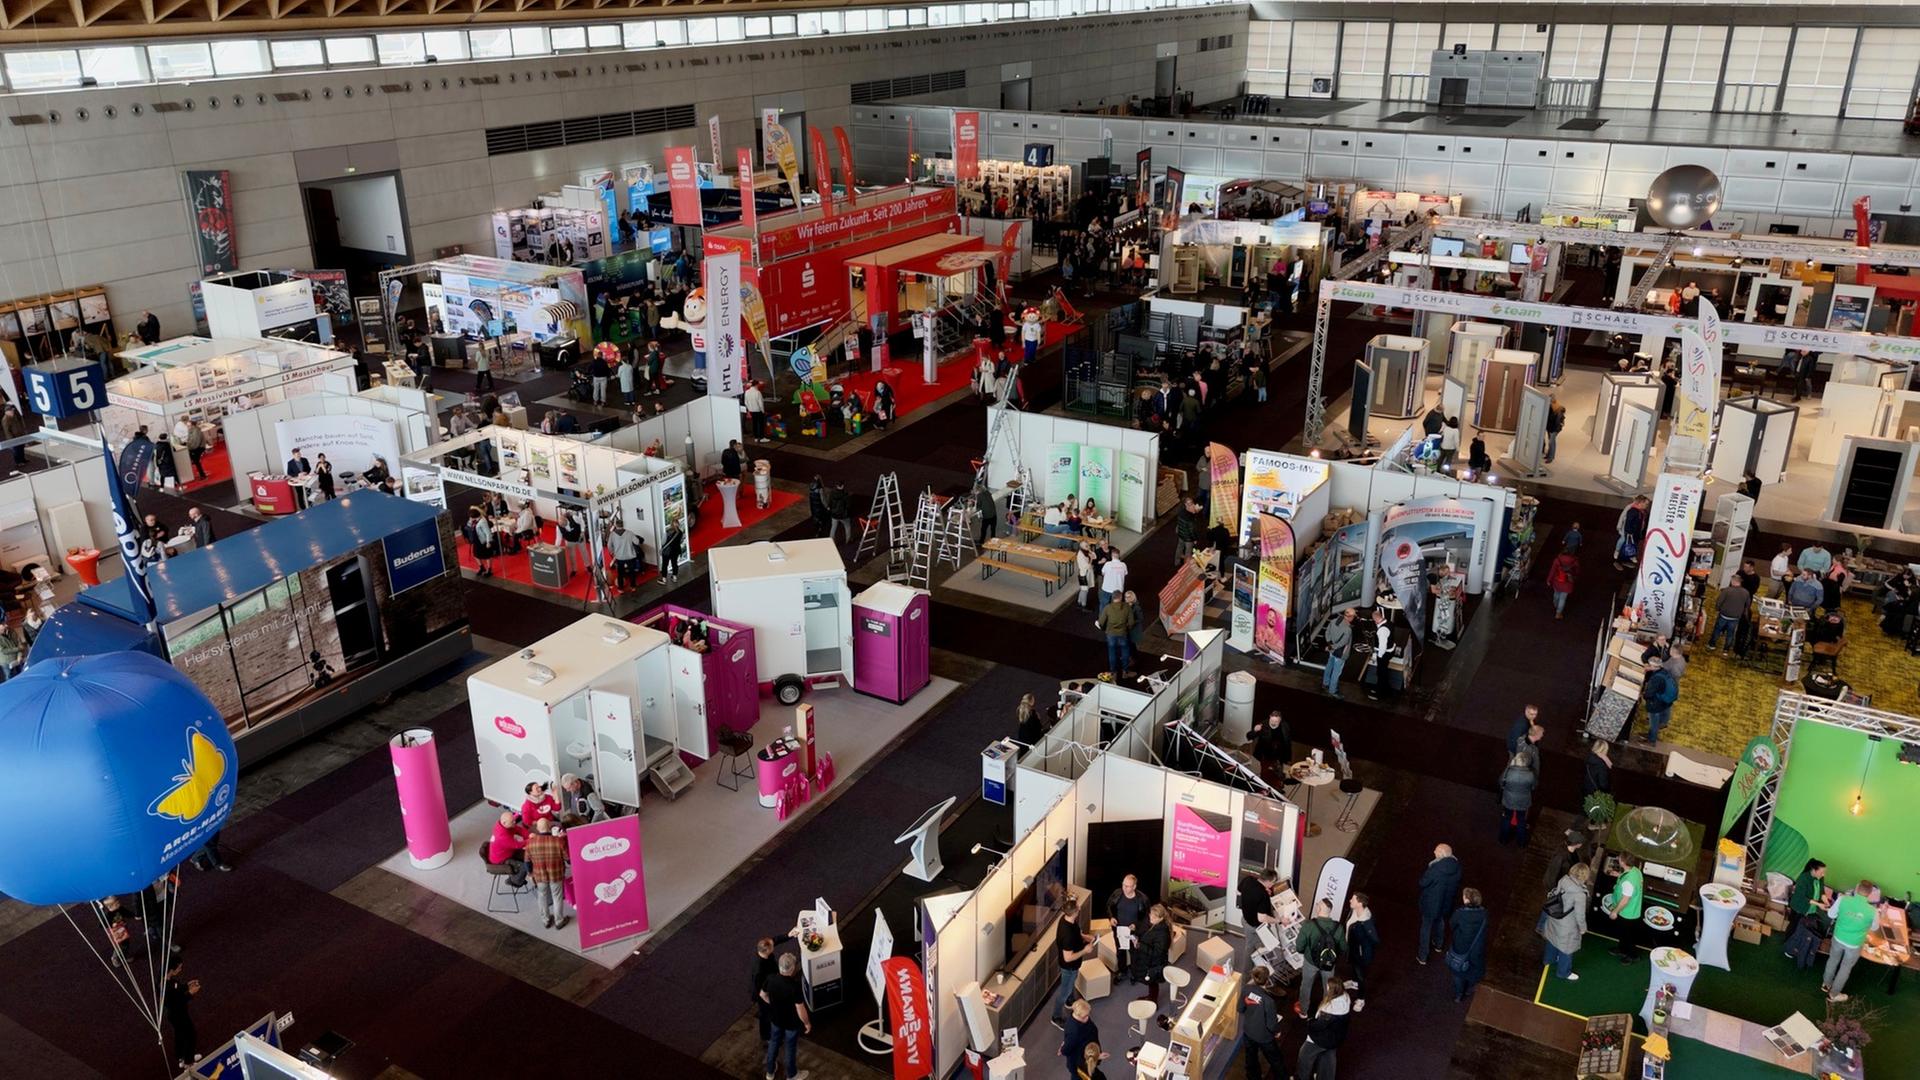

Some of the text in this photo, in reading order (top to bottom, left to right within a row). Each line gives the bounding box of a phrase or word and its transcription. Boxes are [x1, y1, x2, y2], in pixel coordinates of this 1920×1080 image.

[1028, 145, 1038, 165] 4
[798, 199, 929, 240] Wir feiern Zukunft. Seit 200 Jahren.
[1341, 286, 1375, 300] team
[1504, 306, 1542, 319] team
[720, 266, 731, 393] HTL ENERGY
[292, 364, 334, 380] Massivhaus
[30, 374, 51, 412] 5
[69, 370, 95, 410] 5
[184, 388, 242, 408] LS Massivhaus
[446, 470, 533, 498] WWW.NELSONPARK-TD.DE
[596, 466, 677, 506] WWW.NELSONPARK-TD.DE
[1665, 492, 1680, 528] MEISTER
[1676, 494, 1690, 520] MALER
[392, 544, 436, 568] Buderus
[184, 628, 260, 668] Heizsysteme
[260, 620, 280, 636] mit
[163, 802, 229, 854] ARGE-HAUS
